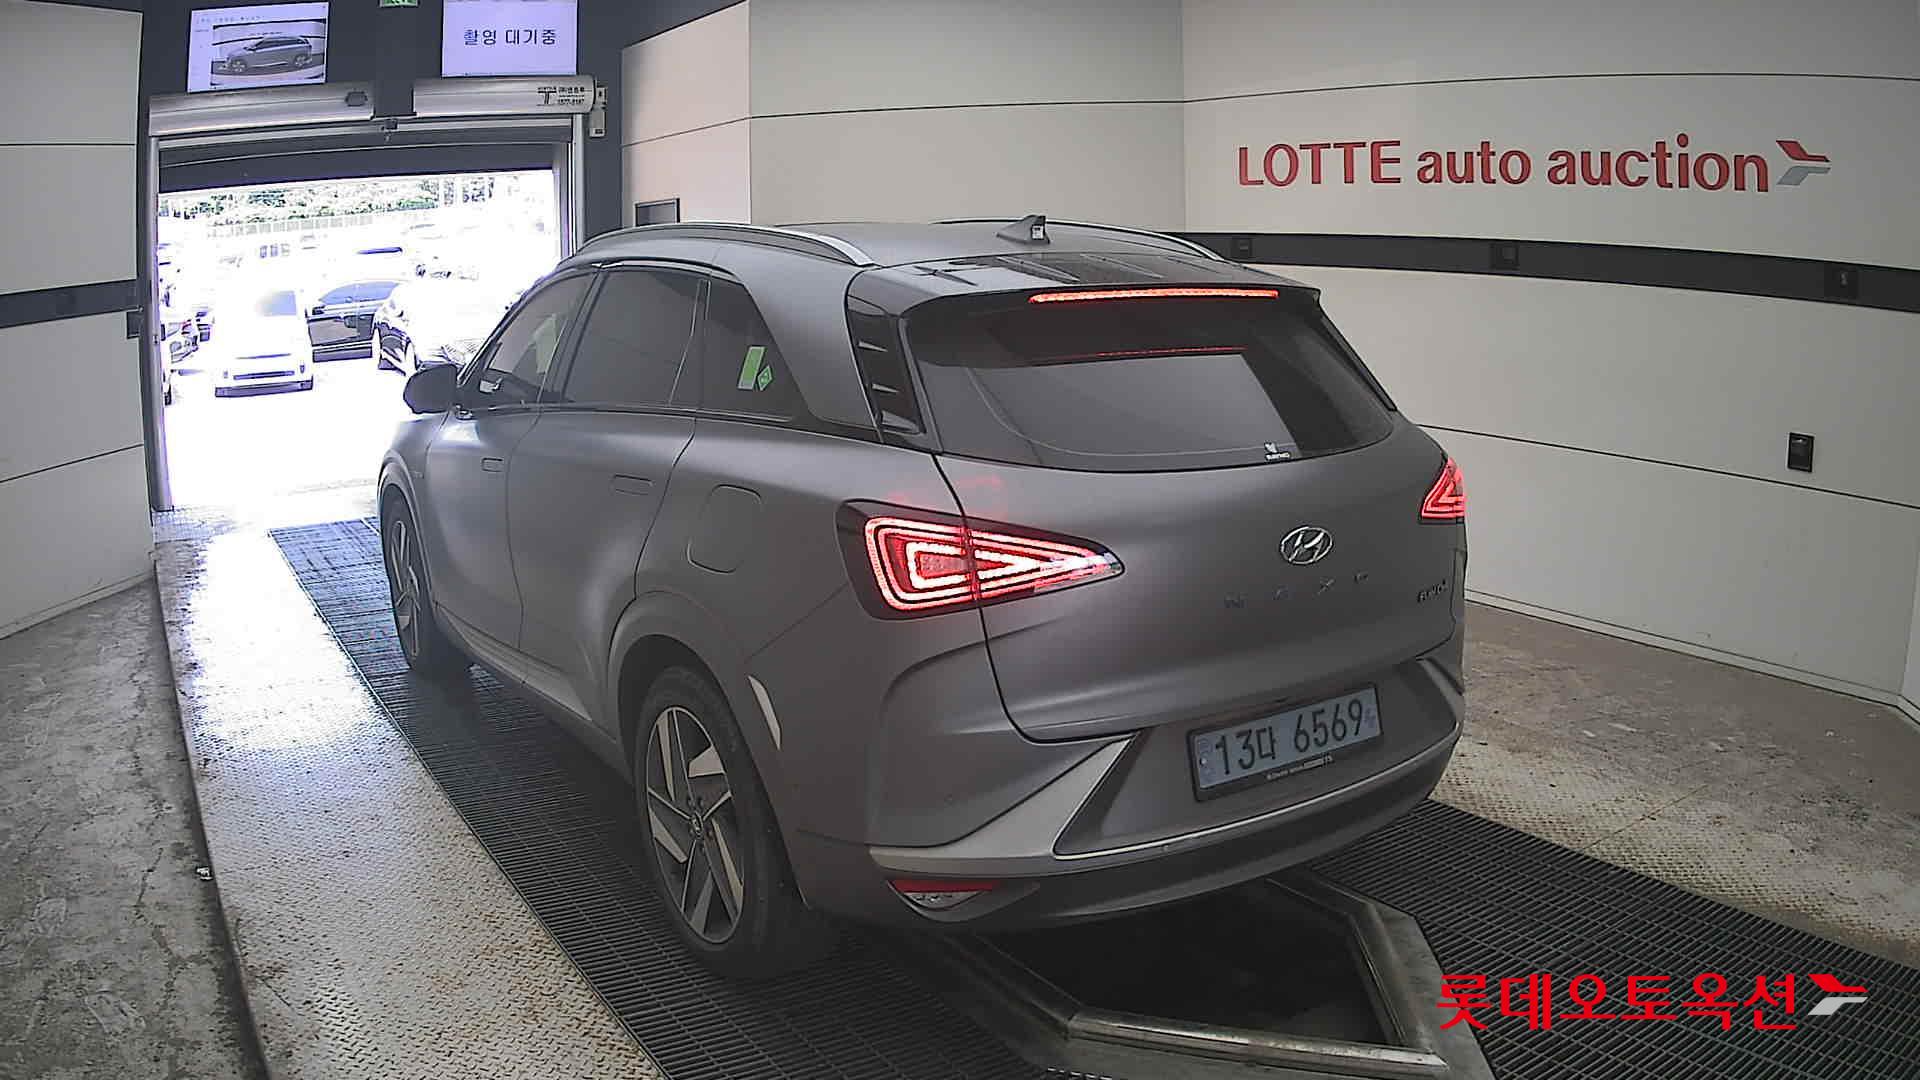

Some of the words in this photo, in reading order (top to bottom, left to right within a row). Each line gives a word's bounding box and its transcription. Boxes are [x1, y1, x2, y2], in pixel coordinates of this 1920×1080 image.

[505, 28, 556, 46] 대기중
[1238, 140, 1401, 187] LOTTE
[1416, 141, 1531, 185] auto
[1547, 133, 1769, 193] auction
[1215, 725, 1276, 775] 13다
[1294, 699, 1363, 753] 6569
